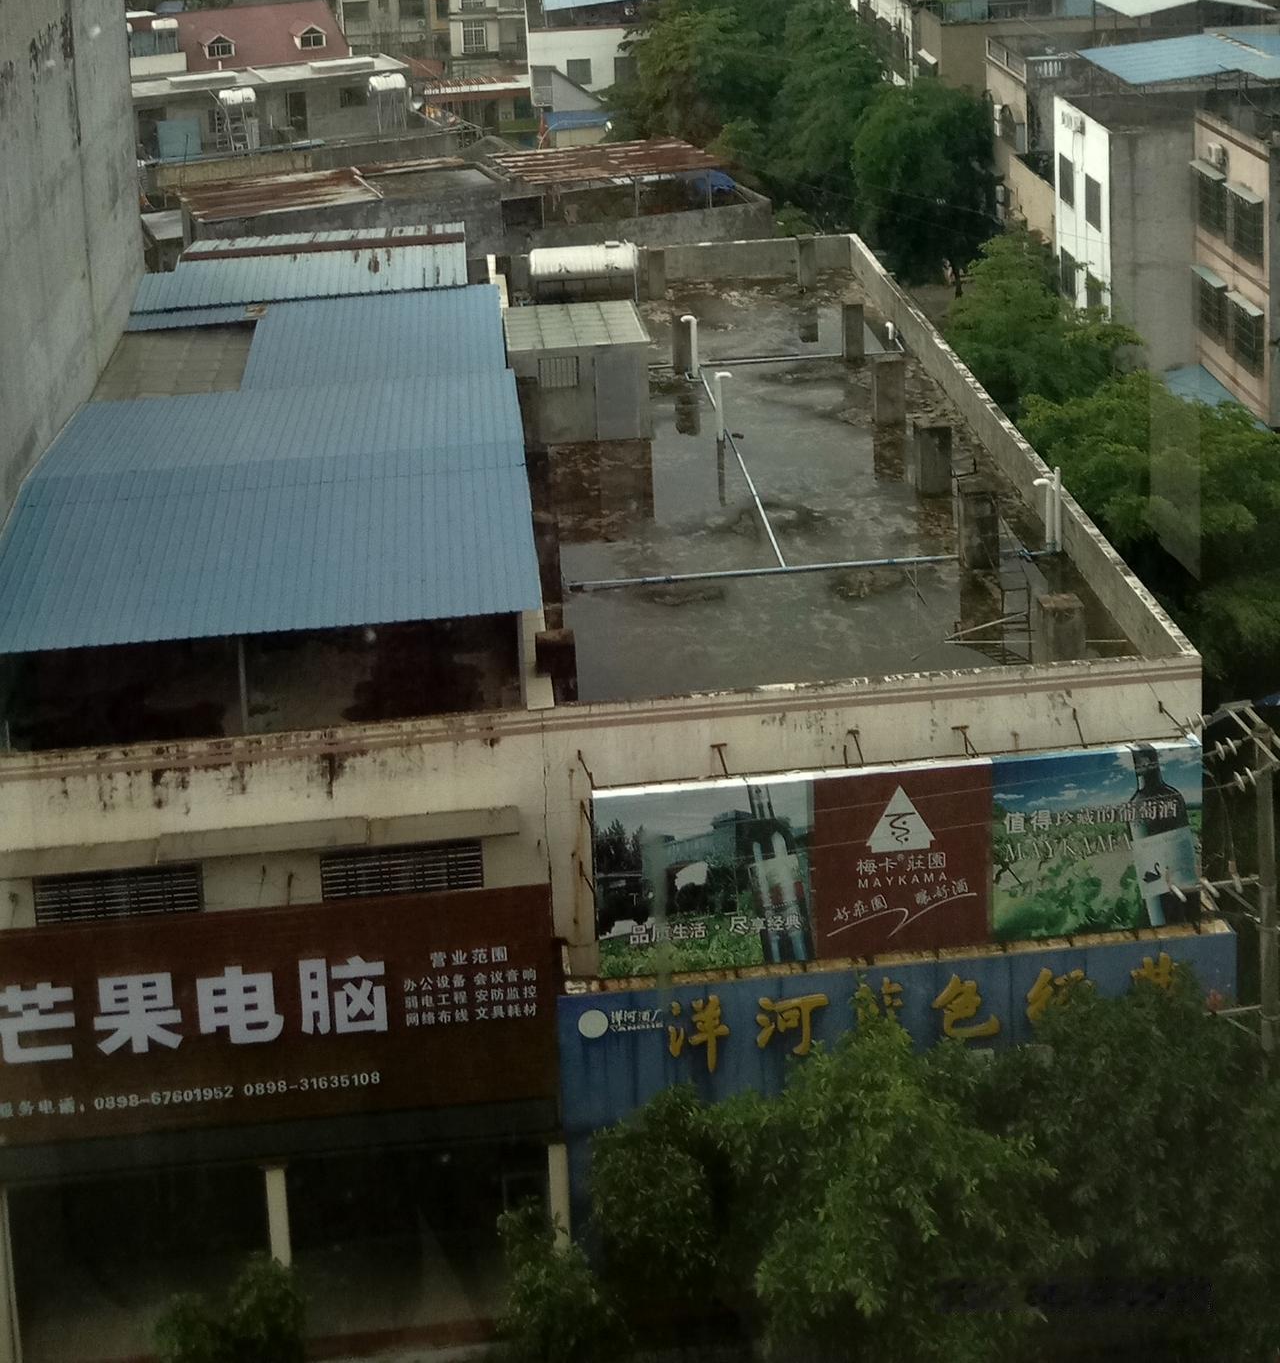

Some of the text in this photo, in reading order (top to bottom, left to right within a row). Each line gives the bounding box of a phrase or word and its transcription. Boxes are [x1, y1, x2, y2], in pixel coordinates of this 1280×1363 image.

[1004, 799, 1178, 834] 值得珍藏的葡萄酒
[857, 871, 948, 890] MAYKAMA
[430, 946, 508, 969] 营业范围
[403, 968, 537, 992] 办公设备 会议音响
[0, 955, 389, 1064] 芒果电脑
[404, 985, 537, 1010] 弱电工程 安防监控
[405, 1003, 537, 1027] 网络布线 文具耗材
[94, 1086, 234, 1111] 0898-67601952
[244, 1071, 381, 1096] 0898-31635108
